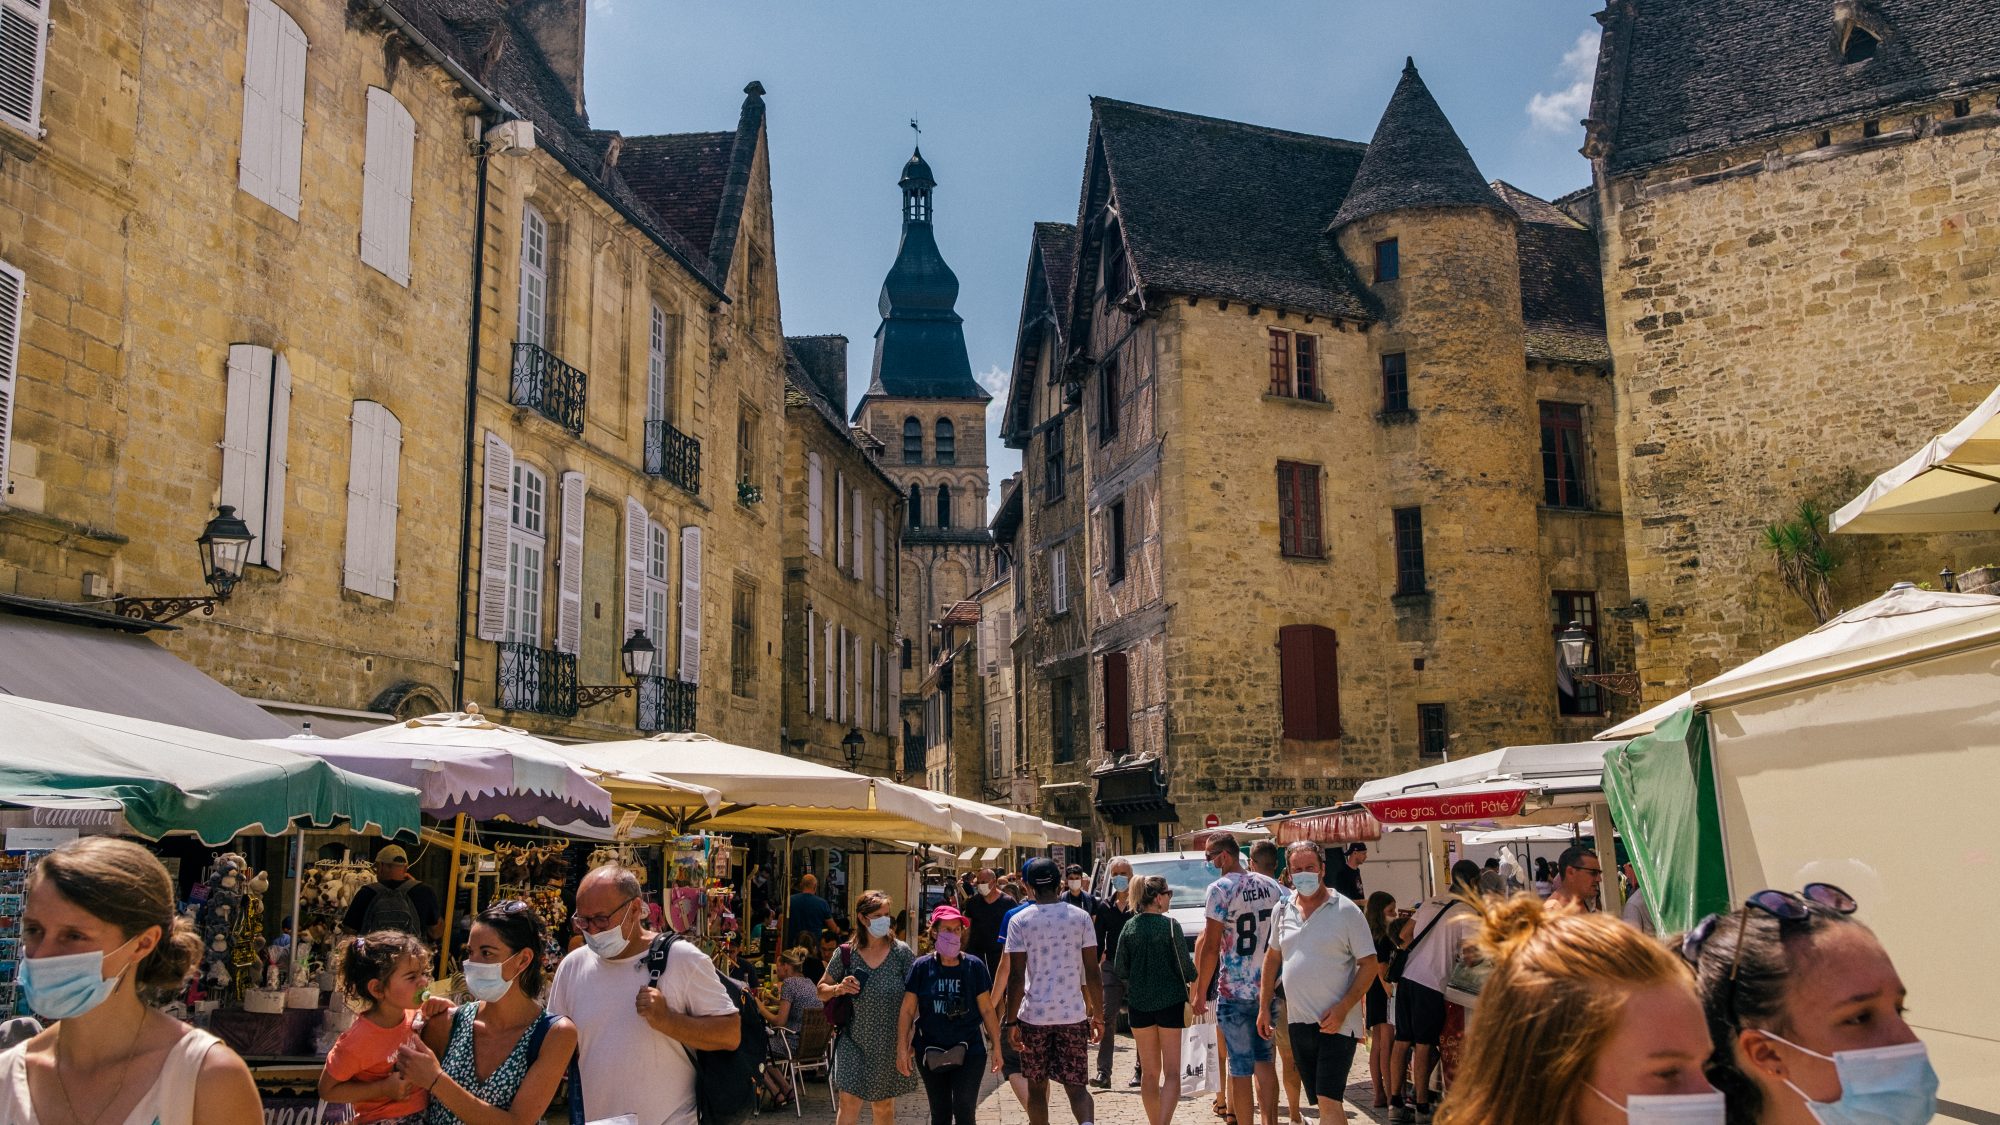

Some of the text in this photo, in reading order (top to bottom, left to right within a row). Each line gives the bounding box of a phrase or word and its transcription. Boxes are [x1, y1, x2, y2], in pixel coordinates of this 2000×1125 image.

[1271, 795, 1338, 808] FOIE GRAS
[1384, 799, 1509, 819] Foie gras, Confit, Pâté
[33, 807, 115, 826] Cadeaux
[1242, 887, 1271, 902] OCEAN
[1236, 908, 1273, 957] 87
